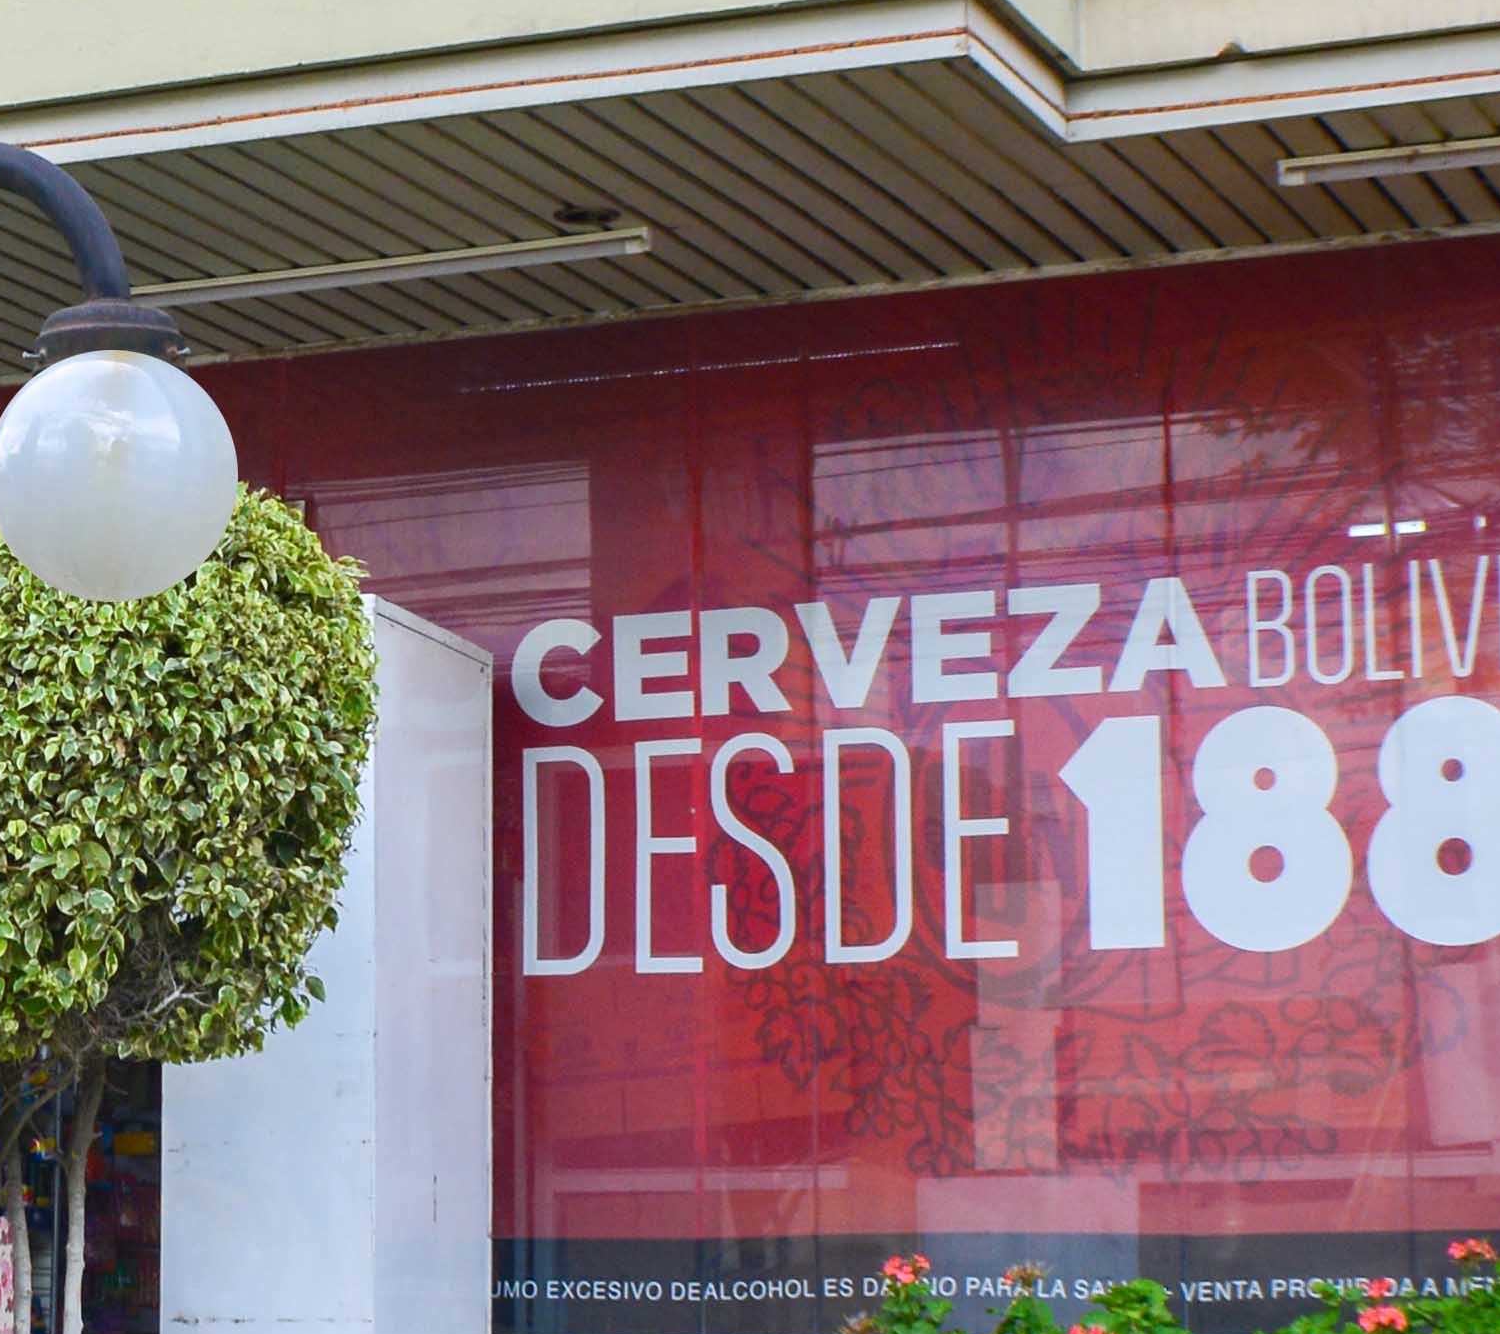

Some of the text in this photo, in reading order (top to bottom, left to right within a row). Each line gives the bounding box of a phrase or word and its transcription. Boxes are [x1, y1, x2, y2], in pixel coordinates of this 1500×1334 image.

[510, 576, 1228, 728] CERVEZA
[522, 718, 1019, 976] DESDE
[546, 1279, 662, 1300] EXCESIVO
[824, 1278, 853, 1298] ES
[863, 1276, 958, 1297] DANO
[1037, 1278, 1067, 1299] LA
[1180, 1279, 1263, 1301] VENTA
[1421, 1276, 1440, 1297] A
